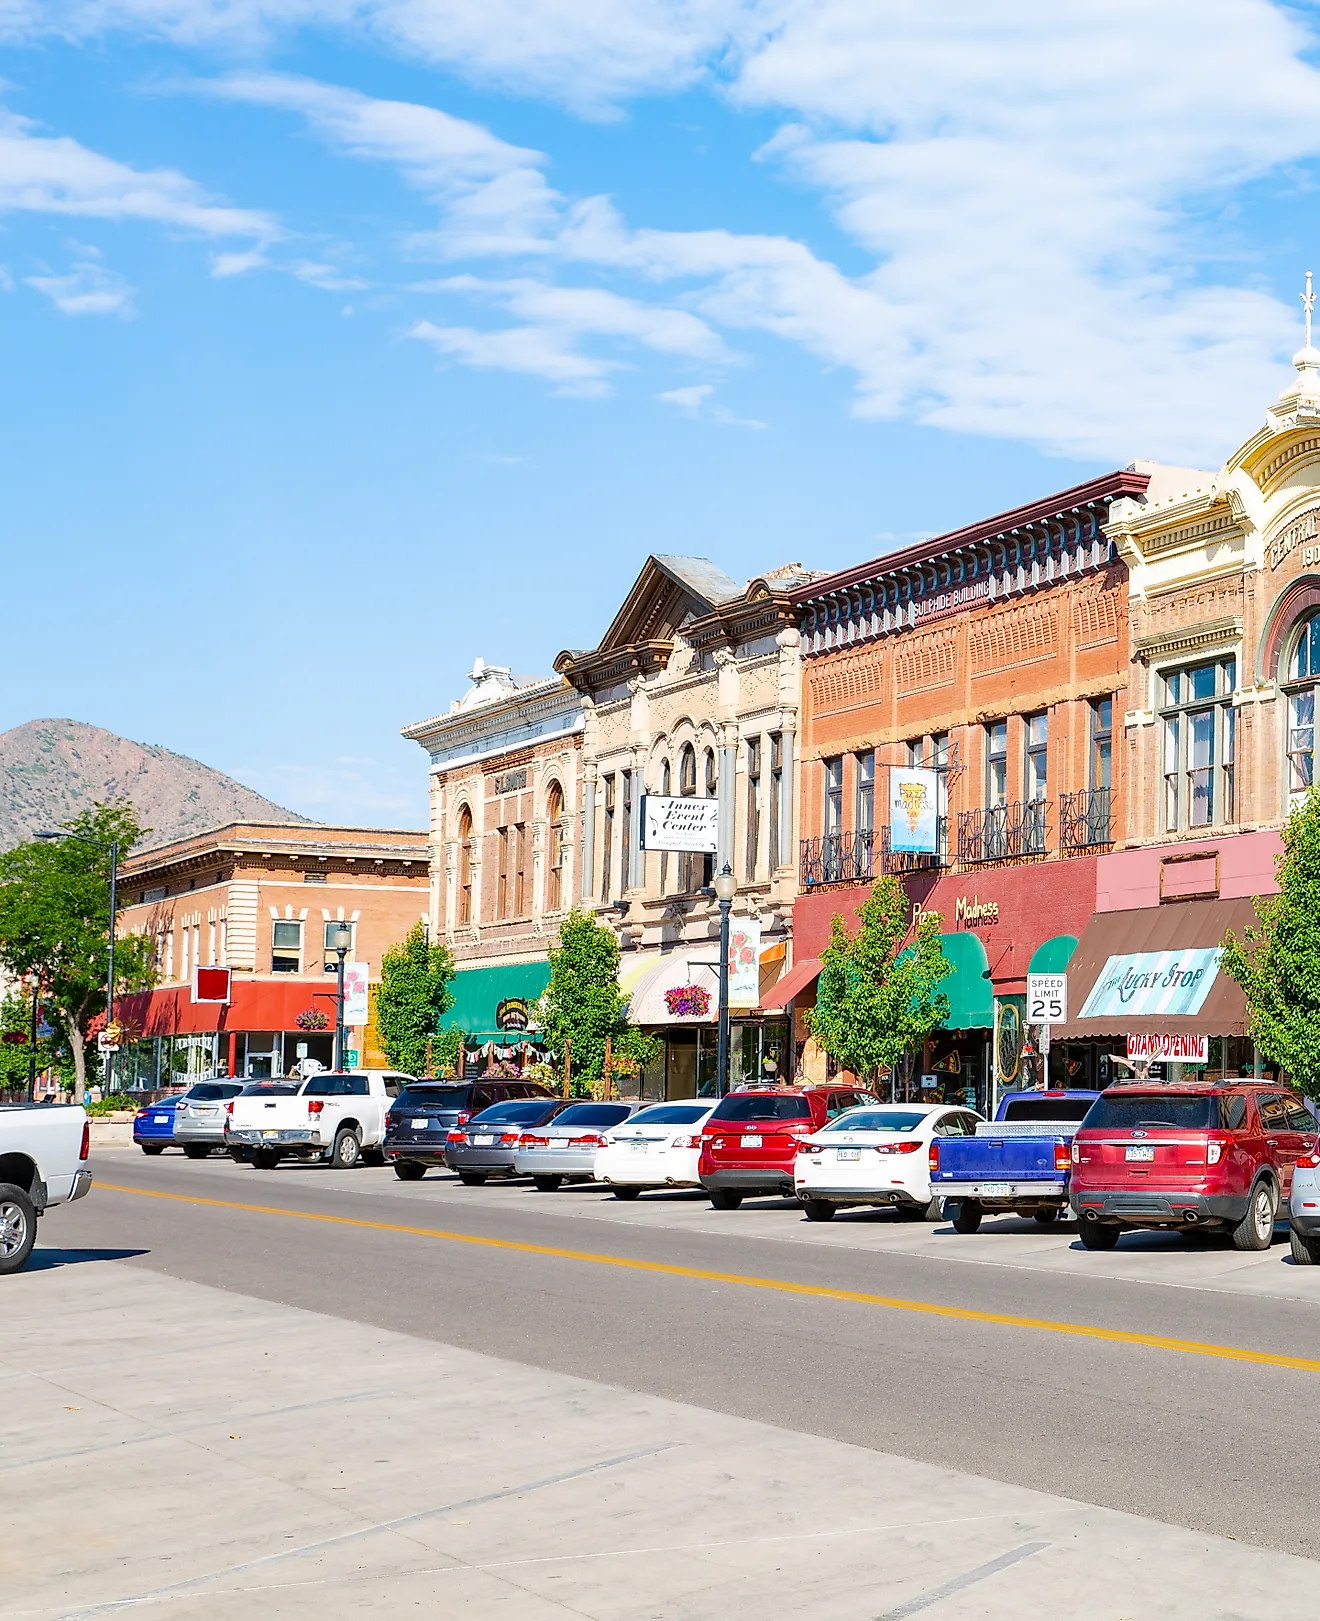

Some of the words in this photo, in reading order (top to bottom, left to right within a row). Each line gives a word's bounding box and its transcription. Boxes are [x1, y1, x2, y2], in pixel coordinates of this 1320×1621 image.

[1271, 514, 1319, 571] CENTRAL
[914, 592, 951, 618] SULPHIDE
[953, 580, 990, 607] BUILDING
[665, 810, 705, 821] Event
[662, 821, 707, 832] Center
[956, 895, 999, 921] Madness
[1031, 979, 1063, 988] SPEED
[1034, 990, 1060, 998] LIMIT
[1032, 1000, 1062, 1017] 25
[1128, 1034, 1160, 1056] GRAND
[1163, 1034, 1204, 1058] OPENING
